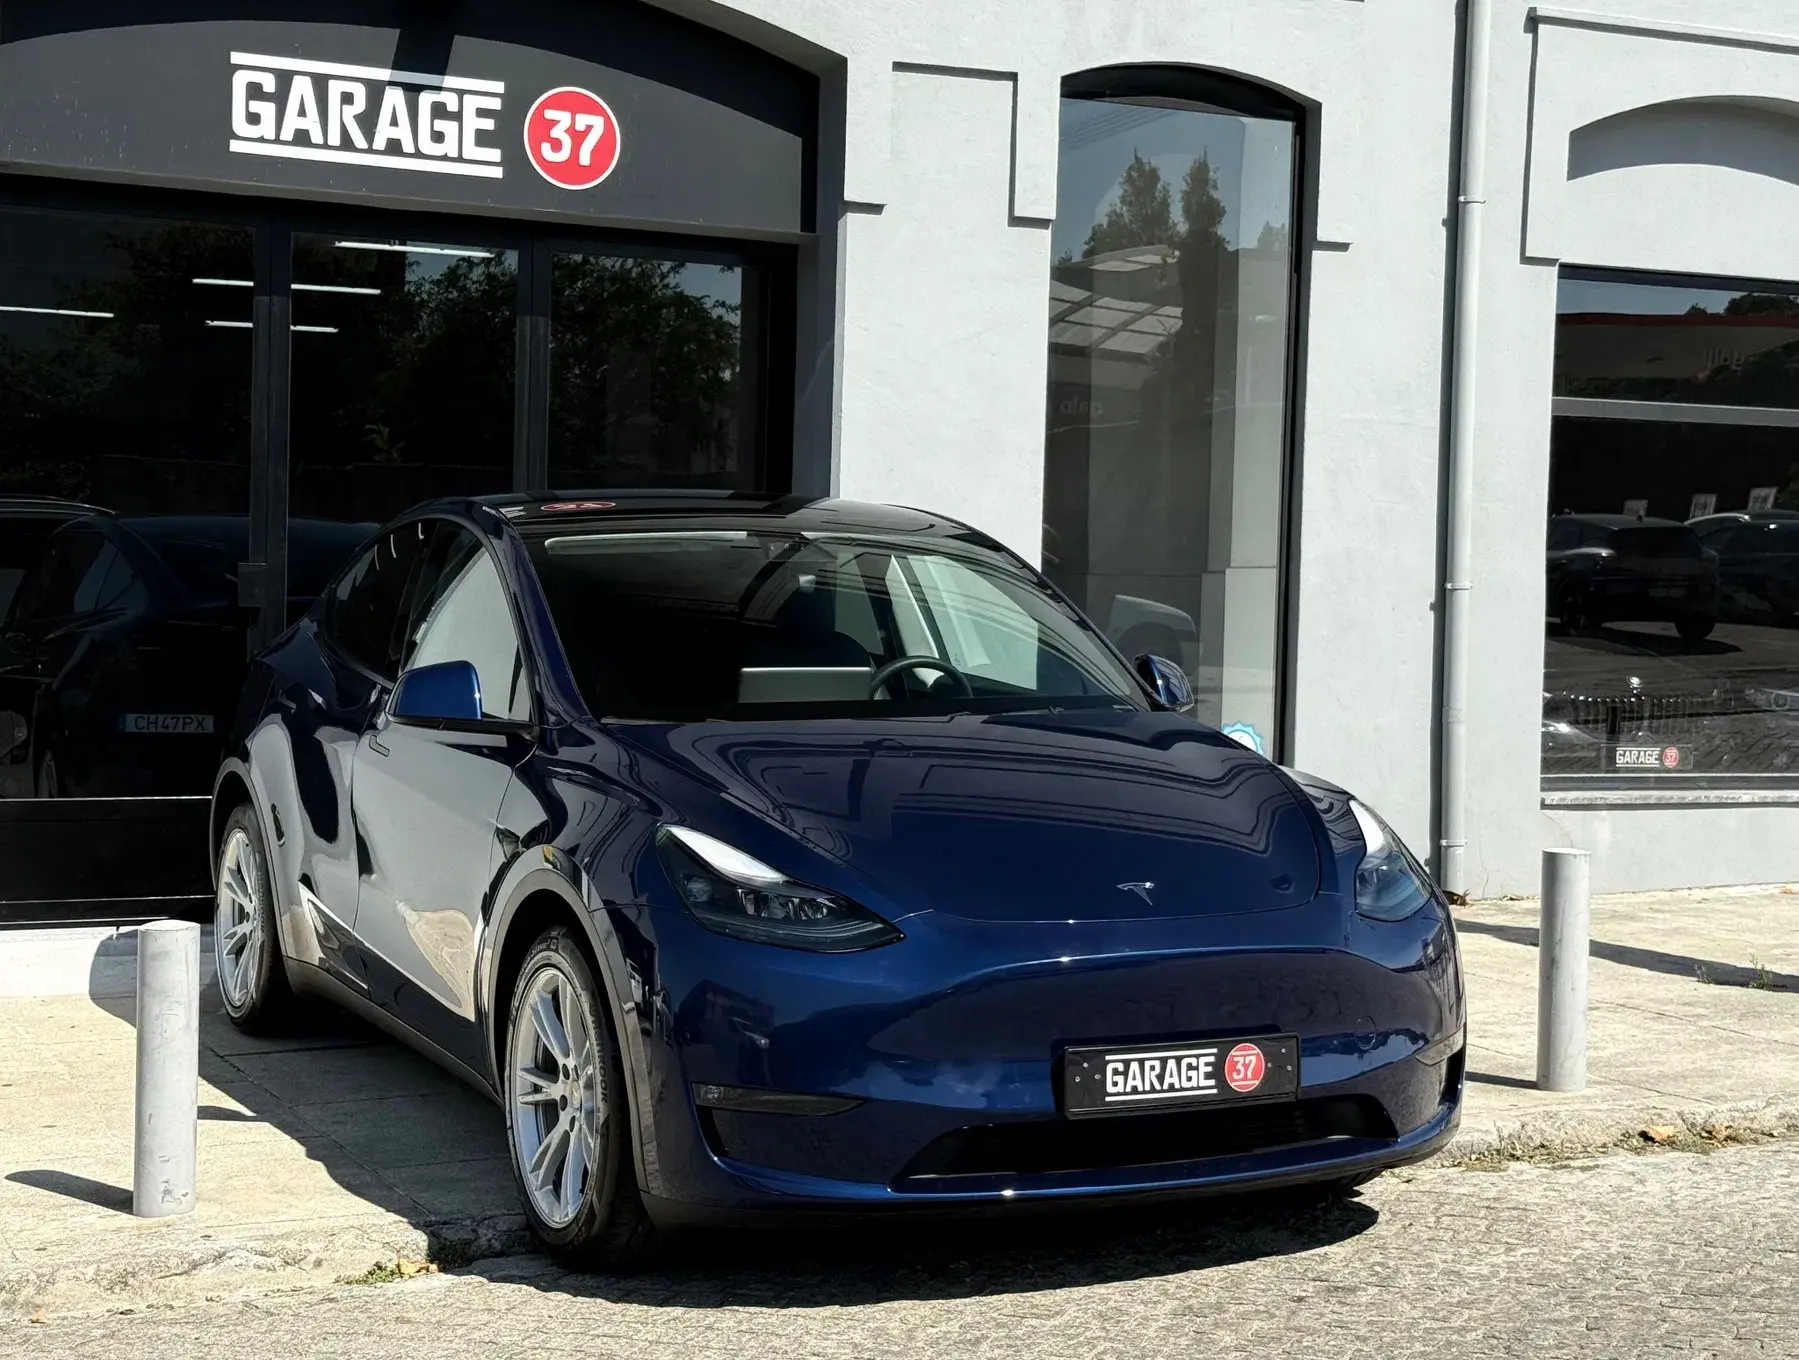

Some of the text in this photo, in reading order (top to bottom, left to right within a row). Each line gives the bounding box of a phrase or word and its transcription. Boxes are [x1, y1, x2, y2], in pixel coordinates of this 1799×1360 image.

[231, 69, 605, 167] GARAGE 37
[1616, 750, 1660, 764] GARAGE
[1105, 1055, 1257, 1094] GARAGE 37
